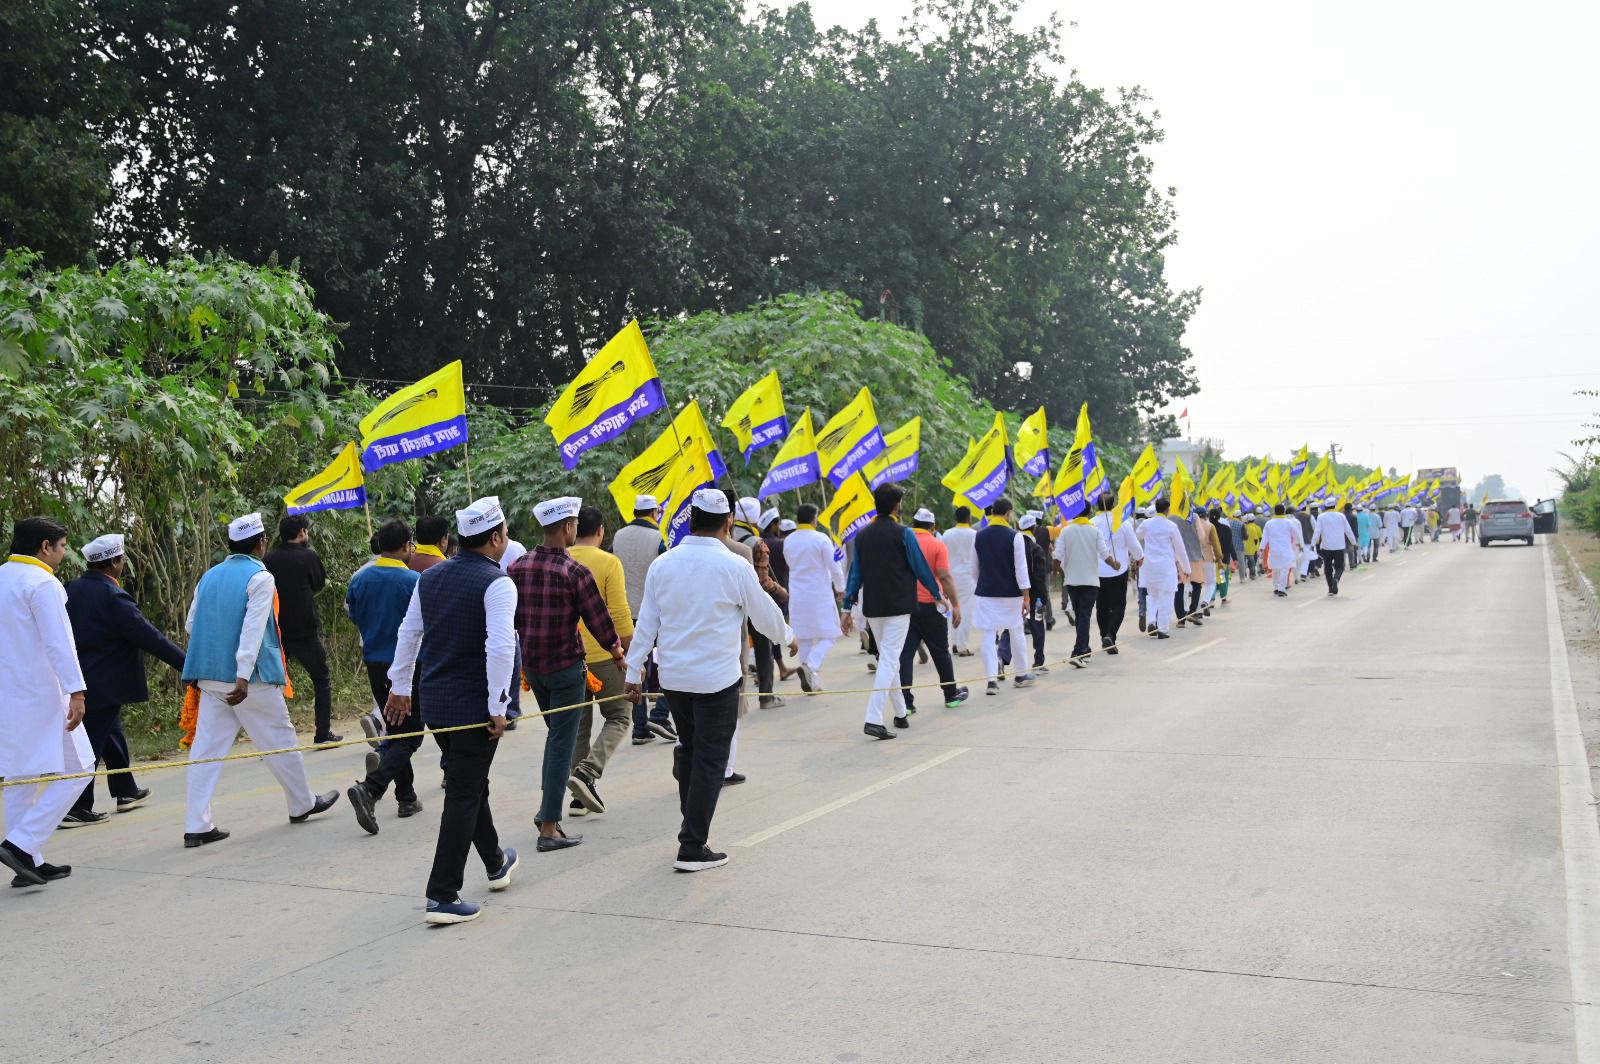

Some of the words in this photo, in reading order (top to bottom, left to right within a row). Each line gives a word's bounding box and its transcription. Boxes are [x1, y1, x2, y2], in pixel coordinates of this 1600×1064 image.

[543, 507, 556, 517] आम
[469, 513, 485, 525] आम
[89, 551, 103, 561] आम
